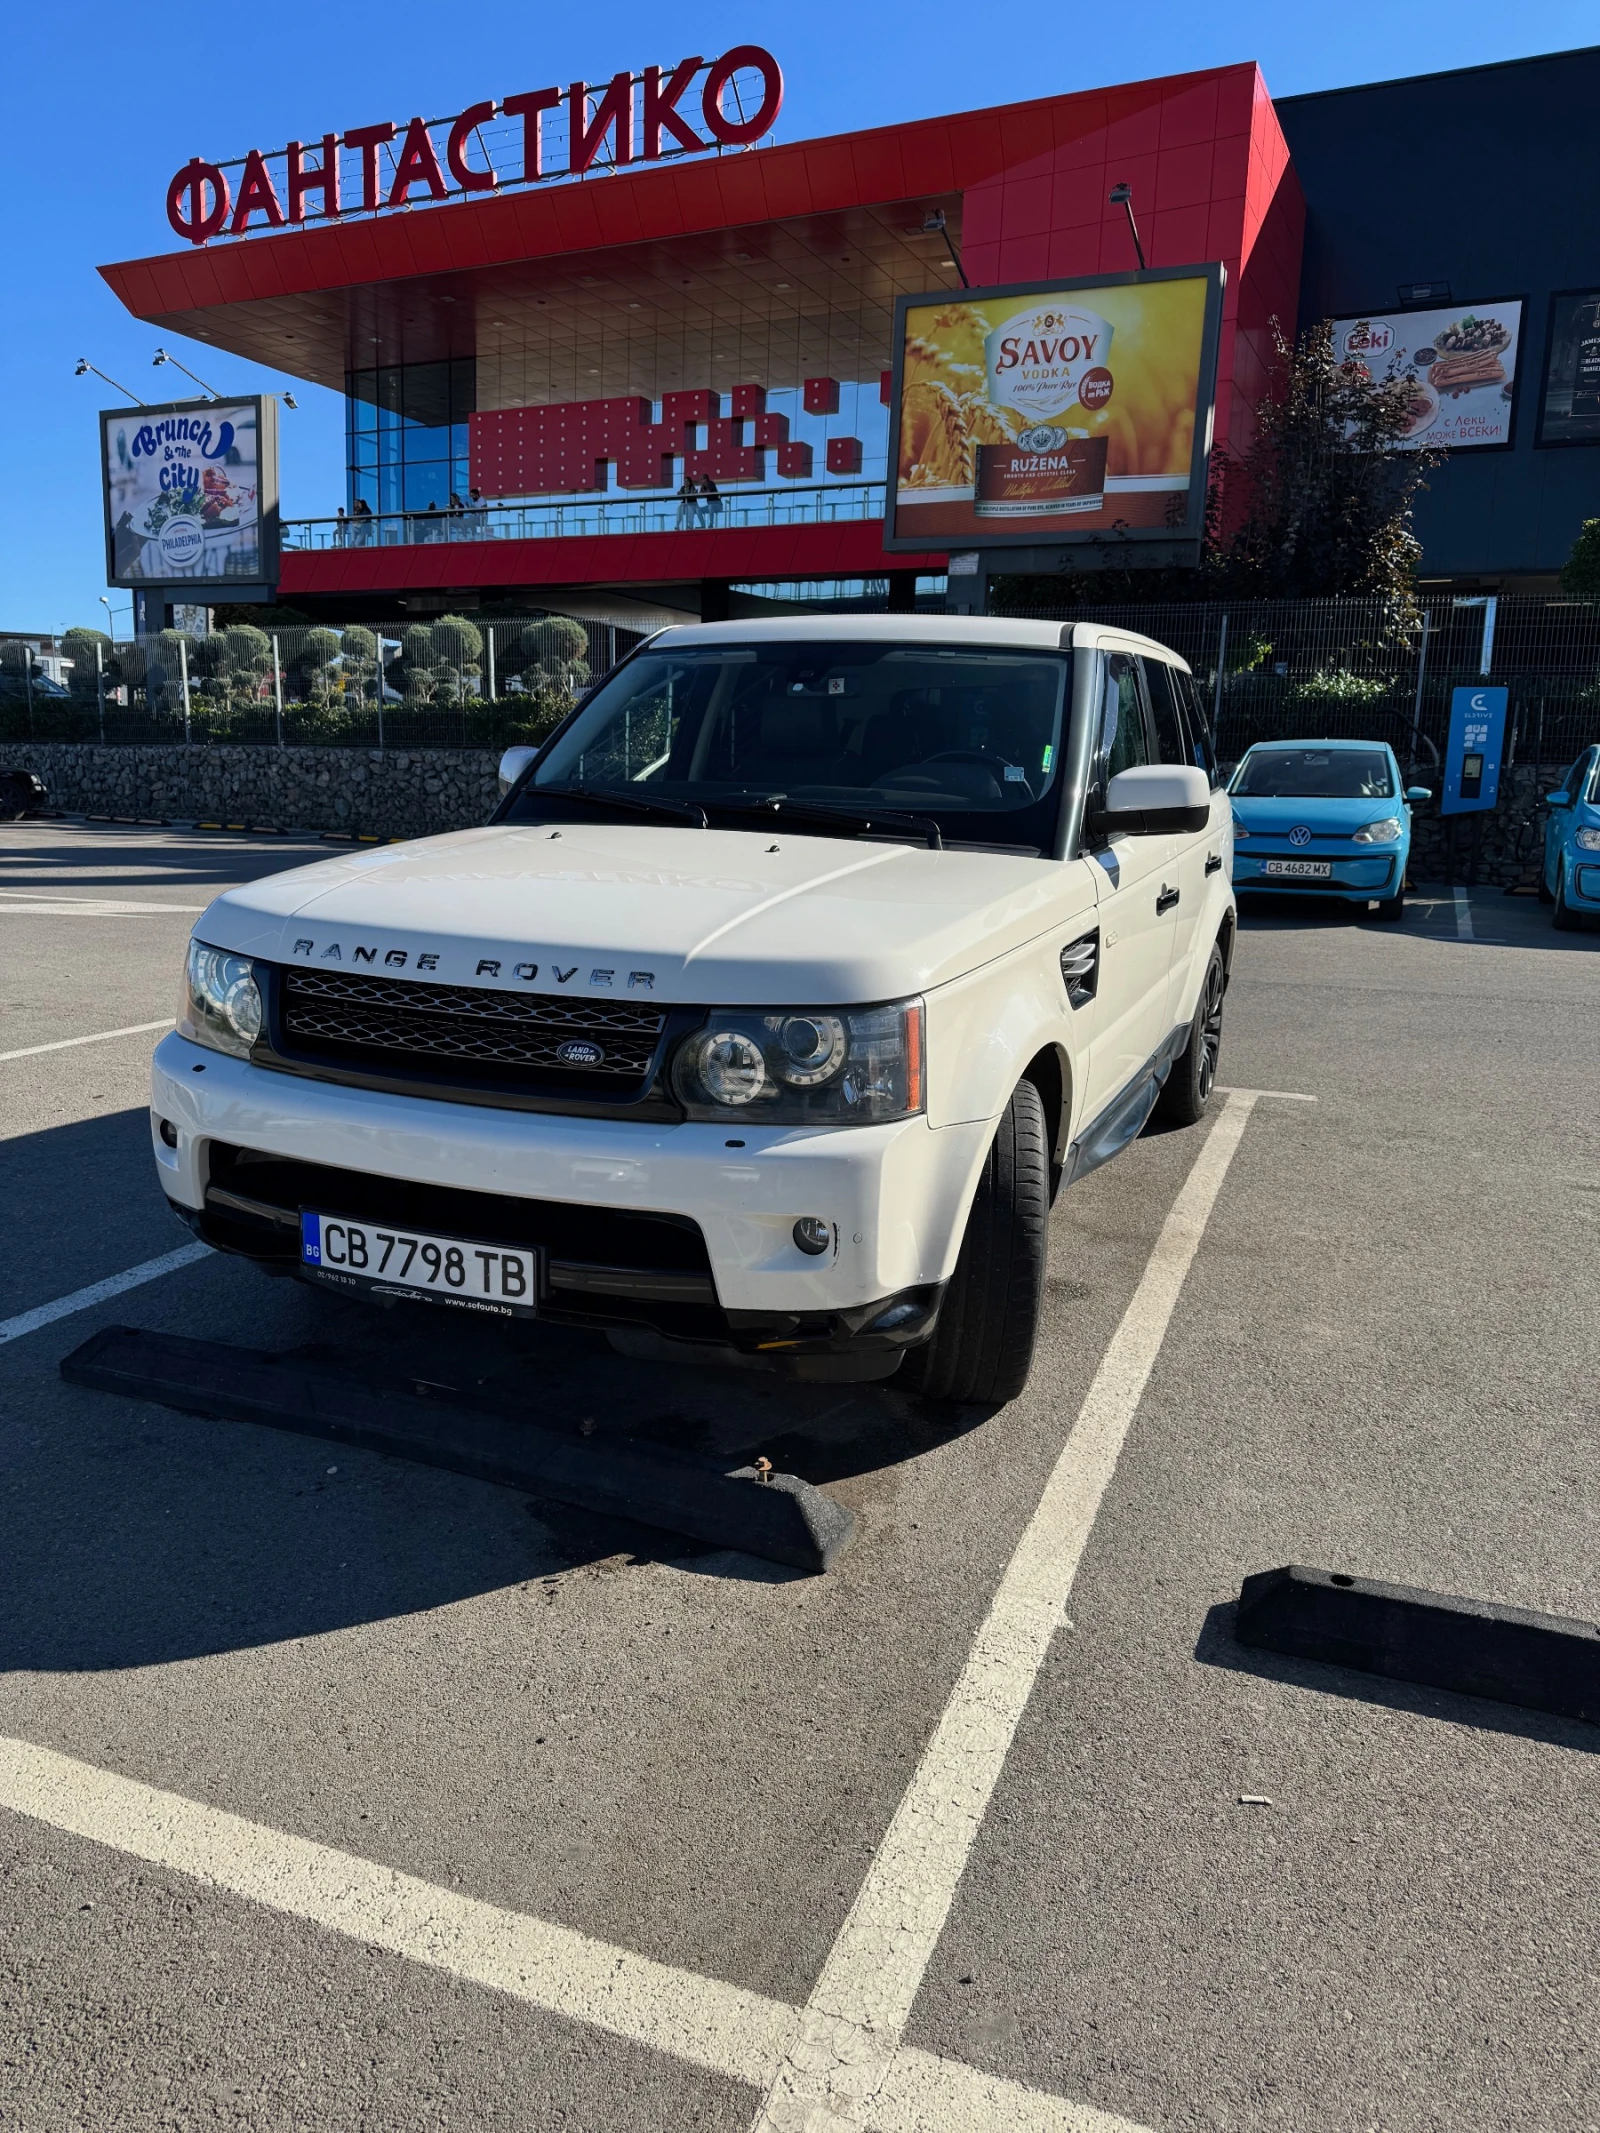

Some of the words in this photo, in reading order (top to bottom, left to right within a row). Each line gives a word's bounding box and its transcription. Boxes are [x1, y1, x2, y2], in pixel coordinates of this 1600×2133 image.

[165, 44, 785, 246] ФАНТАСТИКО
[996, 334, 1098, 374] SAVOY
[1022, 367, 1070, 380] VODKA
[1013, 383, 1035, 393] 100%
[1037, 381, 1058, 393] Pure
[1058, 380, 1077, 390] Rye
[1089, 380, 1110, 389] ВОДКА
[1455, 416, 1486, 427] Леки
[132, 418, 235, 459] Brunch
[1426, 430, 1456, 440] МОЖЕ
[1460, 425, 1502, 438] ВСЕКИ!
[164, 446, 174, 461] &
[1011, 456, 1068, 472] RUŽENA
[162, 533, 202, 551] PHILADELPHIA
[1268, 862, 1282, 873] CB
[1285, 863, 1312, 874] 4682
[1313, 864, 1328, 875] MX
[291, 938, 441, 971] RANGE
[475, 959, 656, 990] ROVER
[569, 1053, 596, 1062] ROVER
[306, 1244, 320, 1258] BG
[325, 1224, 369, 1269] CB
[376, 1233, 466, 1288] 7798
[475, 1250, 526, 1297] TB
[317, 1270, 340, 1283] 02/962
[445, 1297, 512, 1316] www.sofauto.bg
